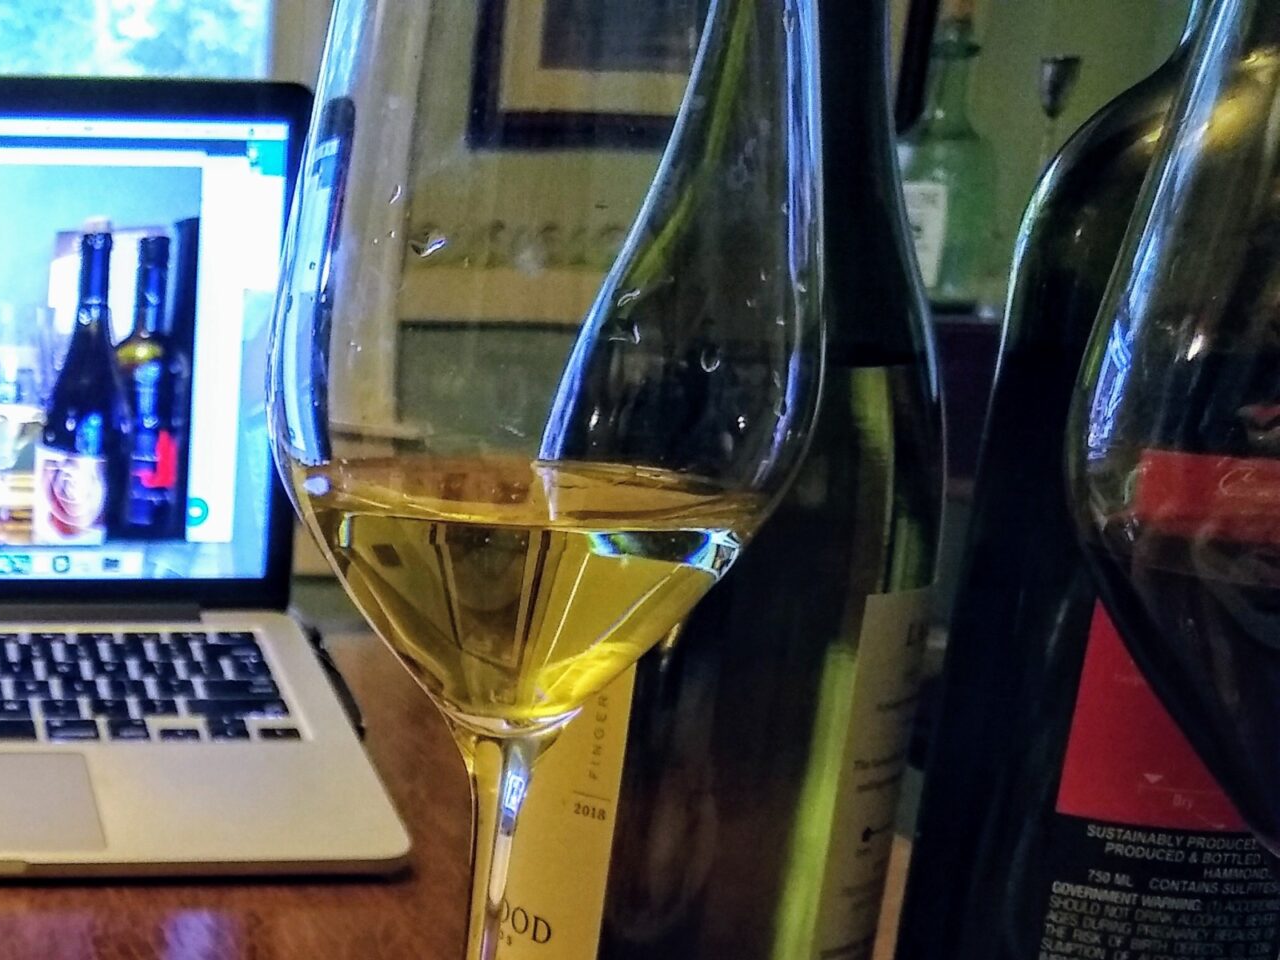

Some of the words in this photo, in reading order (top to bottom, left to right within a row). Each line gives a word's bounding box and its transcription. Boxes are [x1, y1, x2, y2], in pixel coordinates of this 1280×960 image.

[587, 695, 609, 780] FINGER
[573, 802, 607, 822] 2018
[1086, 823, 1184, 848] SUSTAINABLY
[1104, 841, 1185, 863] PRODUCED
[1188, 852, 1198, 864] &
[1201, 852, 1262, 866] BOTTLED
[1087, 868, 1111, 885] 750
[1114, 872, 1134, 888] ML
[1203, 867, 1272, 881] HAMMOND
[1051, 880, 1139, 905] GOVERNMENT
[1149, 878, 1219, 894] CONTAINS
